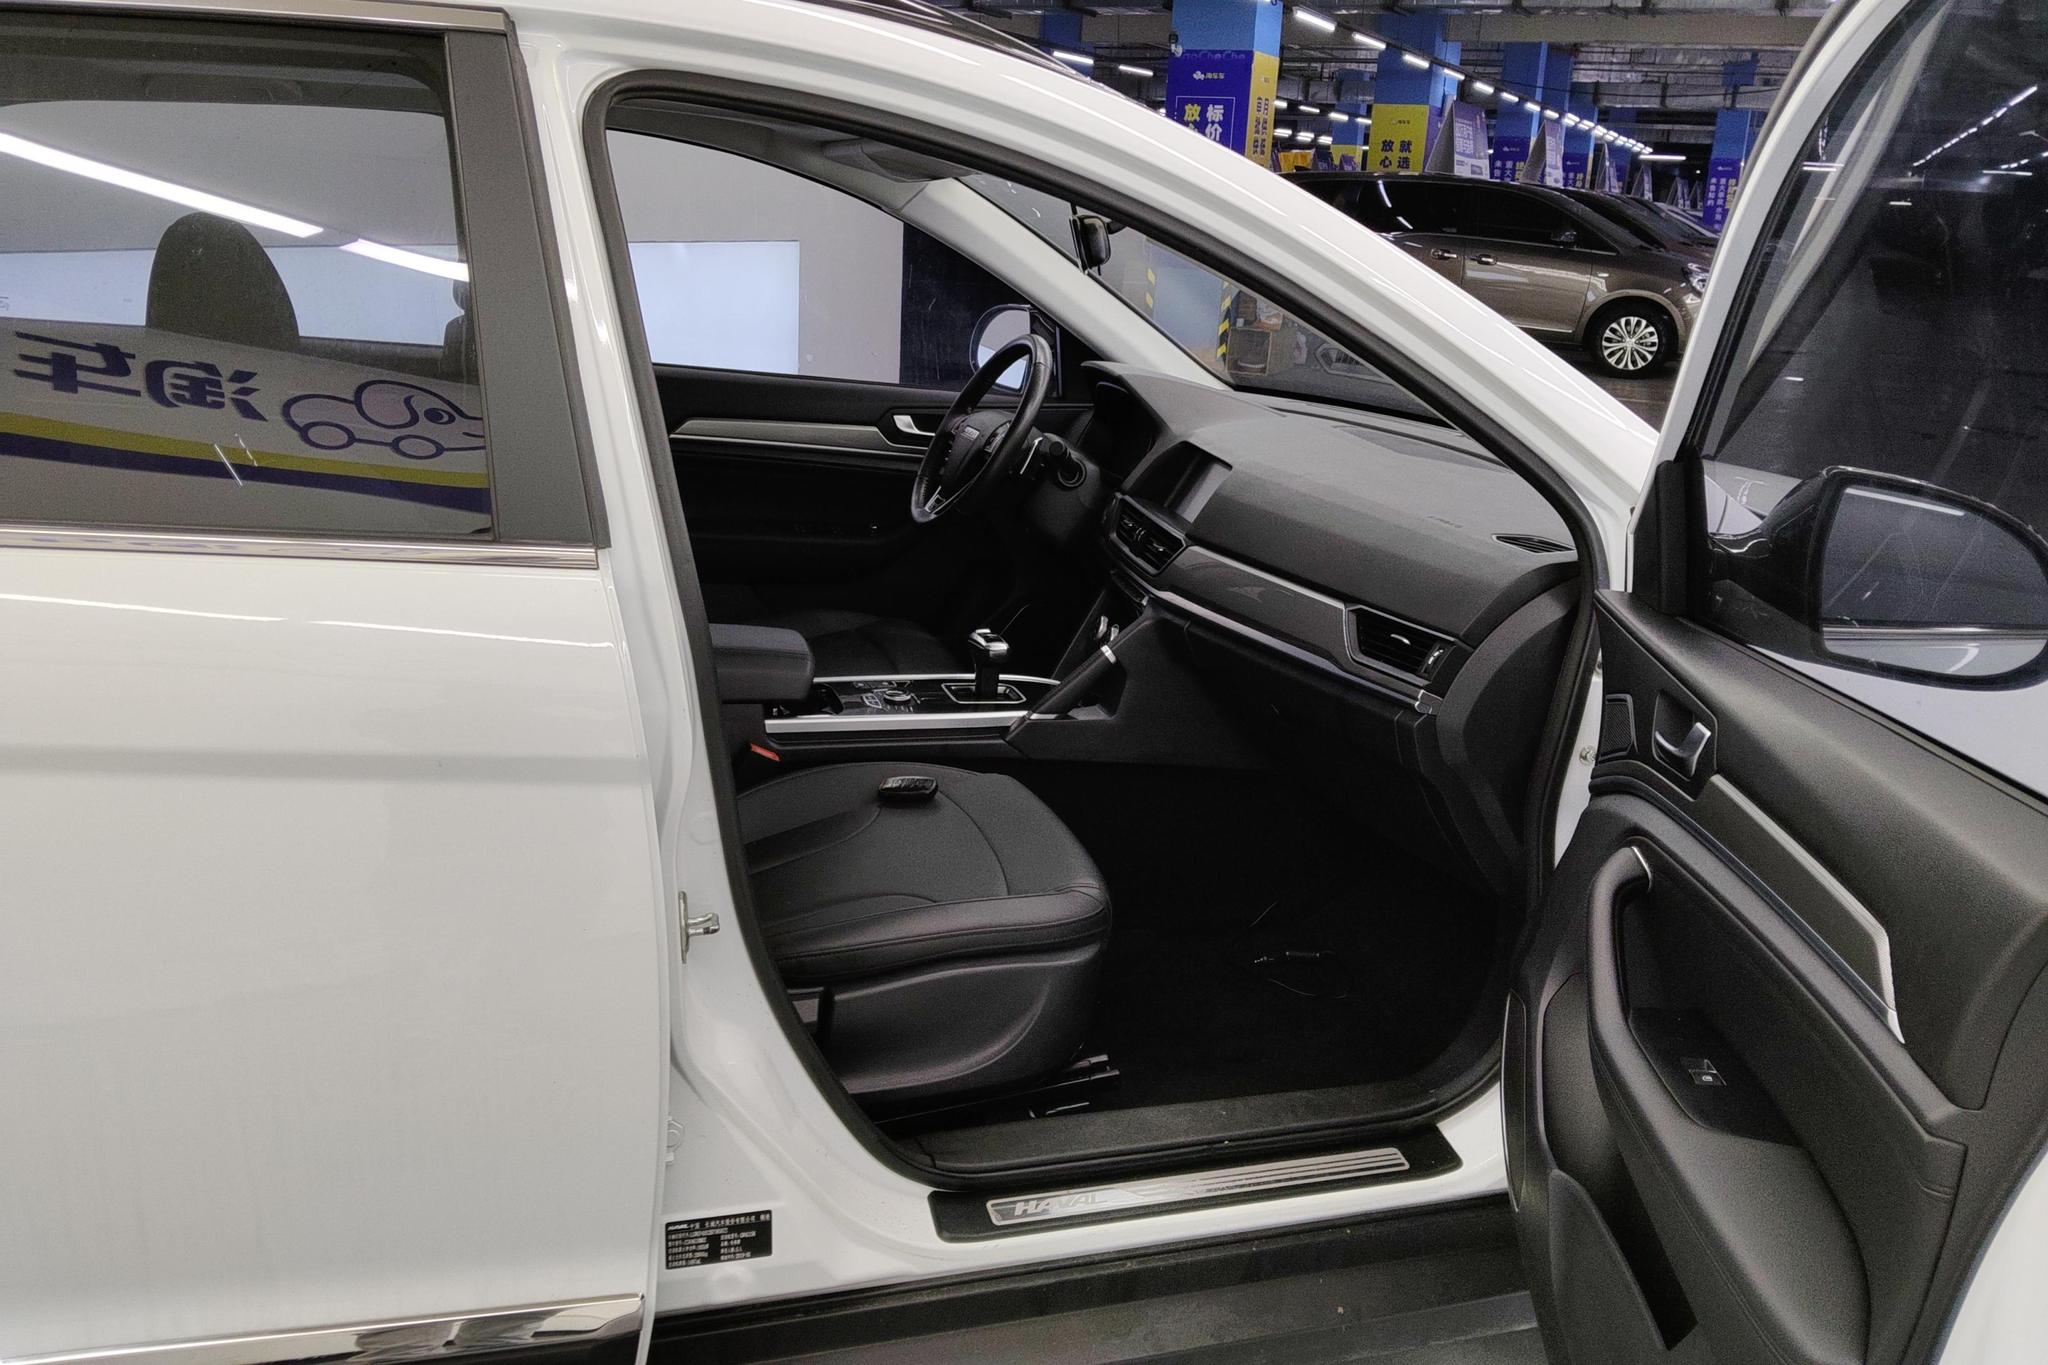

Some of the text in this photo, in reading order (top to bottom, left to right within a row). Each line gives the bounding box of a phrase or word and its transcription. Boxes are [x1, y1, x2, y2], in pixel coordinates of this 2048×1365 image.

[1205, 103, 1224, 141] 标价
[1379, 139, 1395, 168] 放心
[1396, 139, 1413, 169] 就选
[1014, 1191, 1108, 1216] HAVAL
